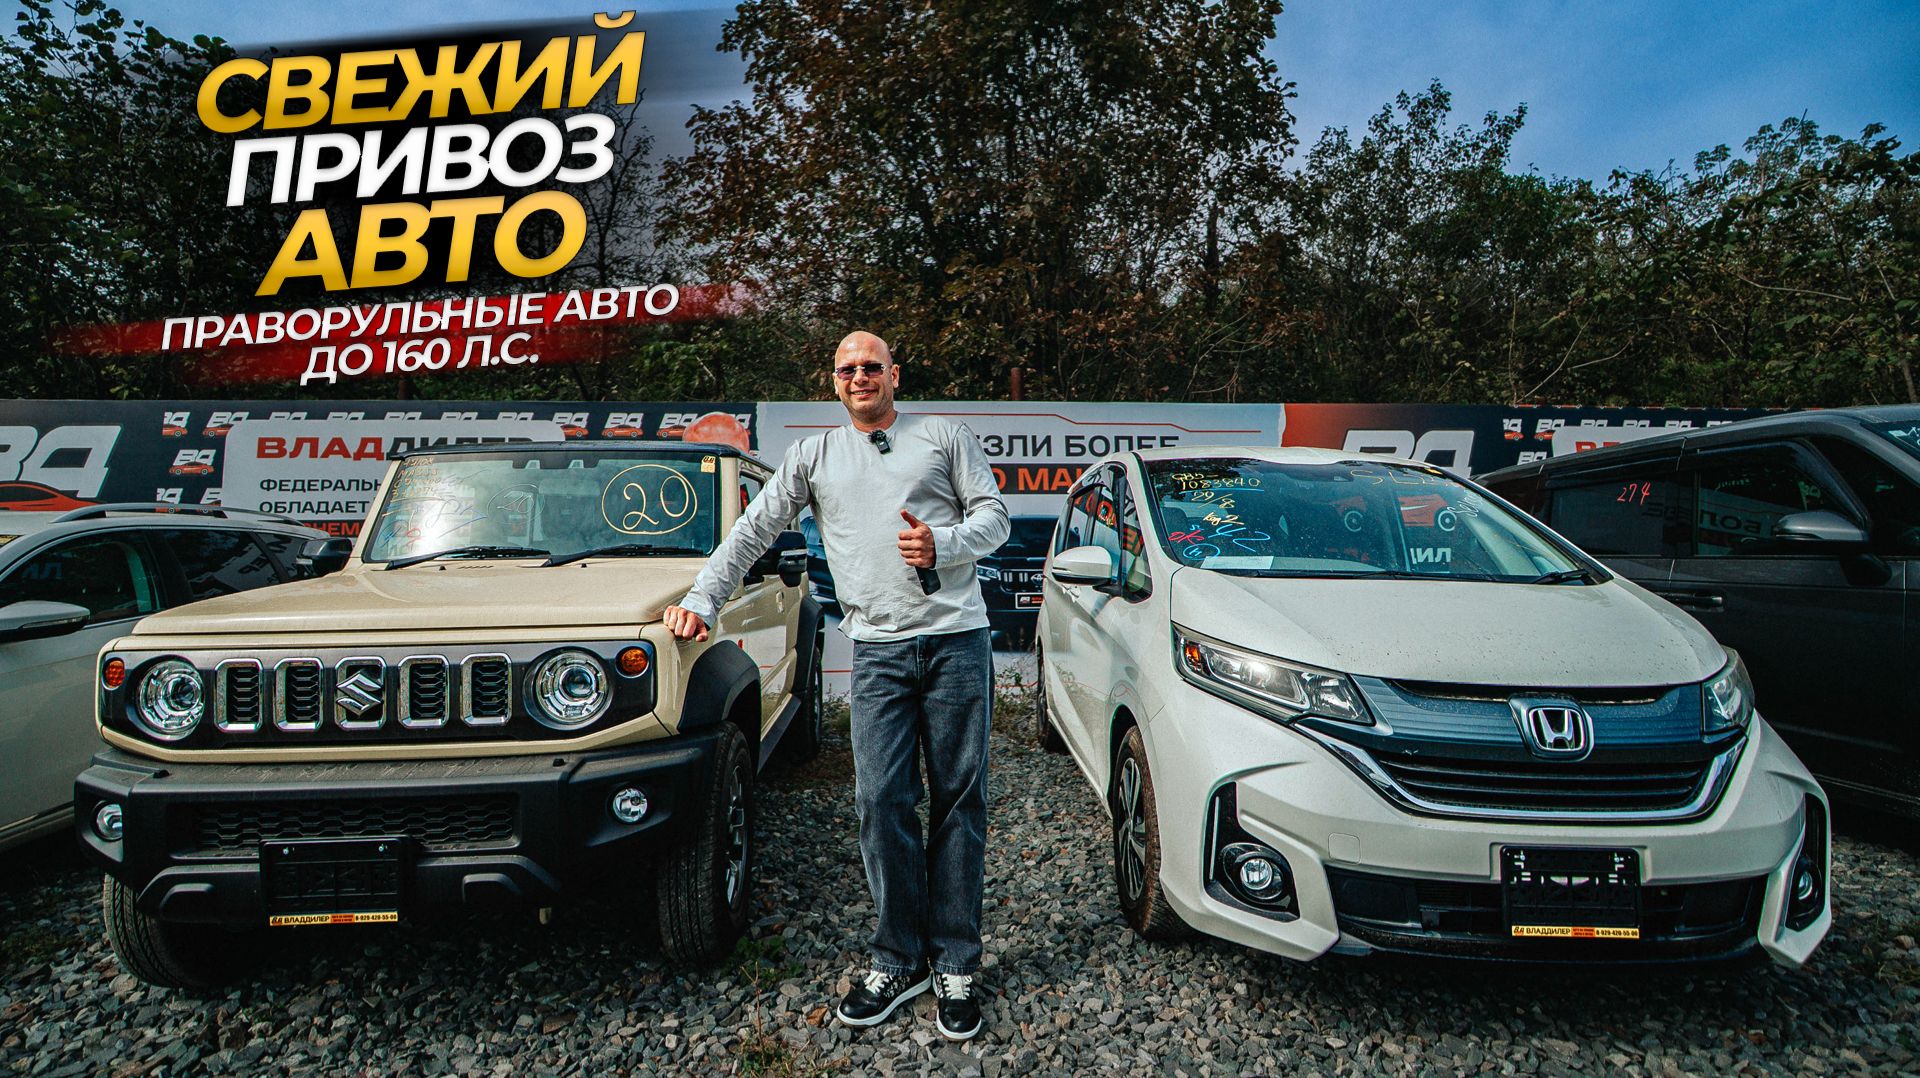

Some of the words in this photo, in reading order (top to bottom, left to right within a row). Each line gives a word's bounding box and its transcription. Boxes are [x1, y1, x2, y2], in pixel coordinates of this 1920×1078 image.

[256, 437, 533, 460] ВЛАДД
[976, 435, 1052, 457] ЗЛИ
[1018, 467, 1083, 492] МА
[623, 476, 690, 530] 20
[1617, 481, 1651, 506] 274
[259, 501, 370, 514] ОБЛАДАЕТ
[284, 915, 330, 924] ВЛАДДИЛЕР
[1526, 927, 1571, 935] ВЛАДДИЛЕР
